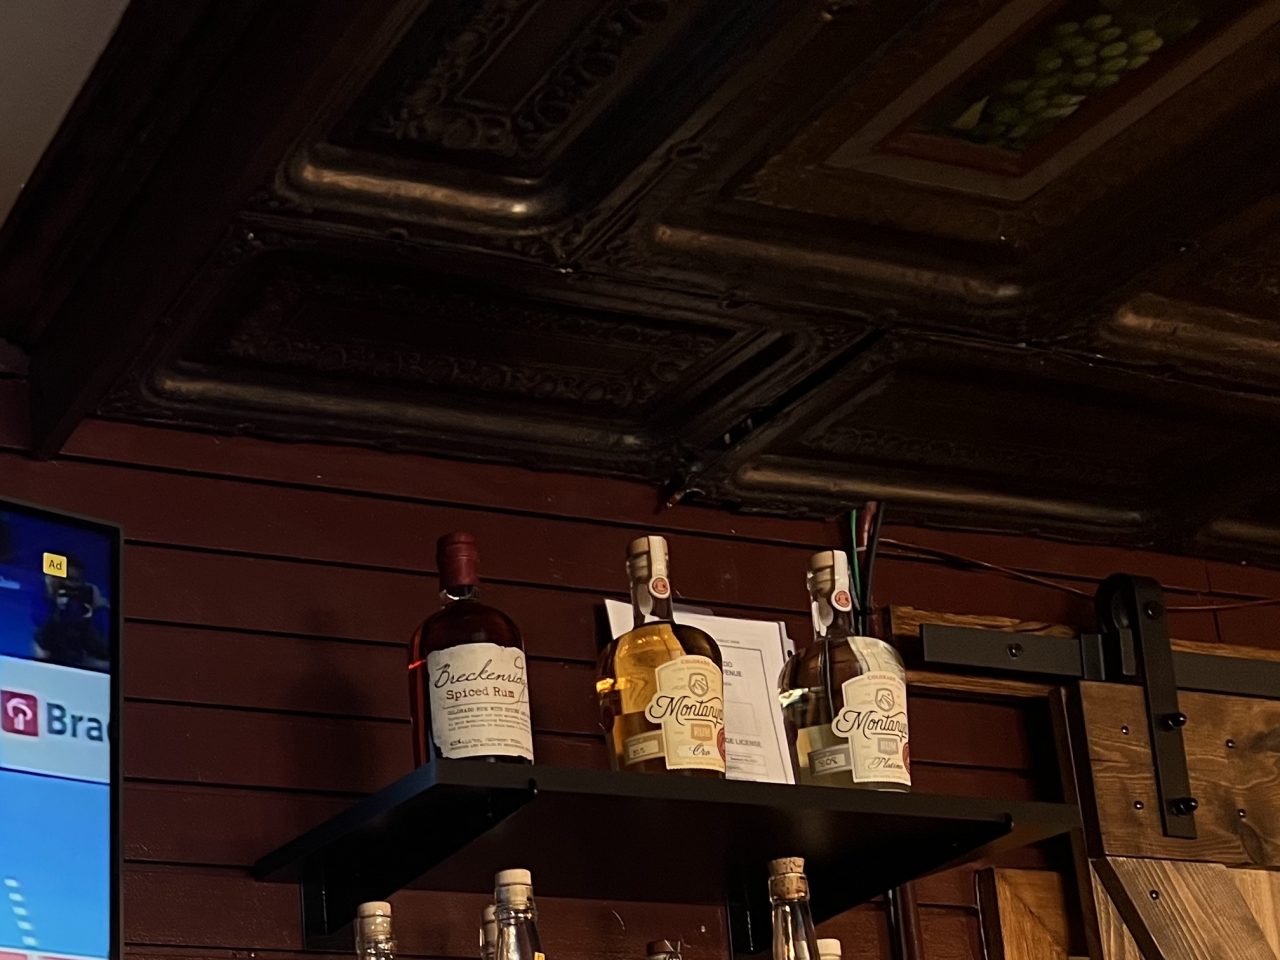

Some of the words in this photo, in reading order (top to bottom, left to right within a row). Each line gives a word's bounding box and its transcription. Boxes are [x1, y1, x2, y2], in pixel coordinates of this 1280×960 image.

[49, 559, 63, 571] Ad
[446, 687, 489, 701] Spiced
[493, 687, 515, 698] Rum
